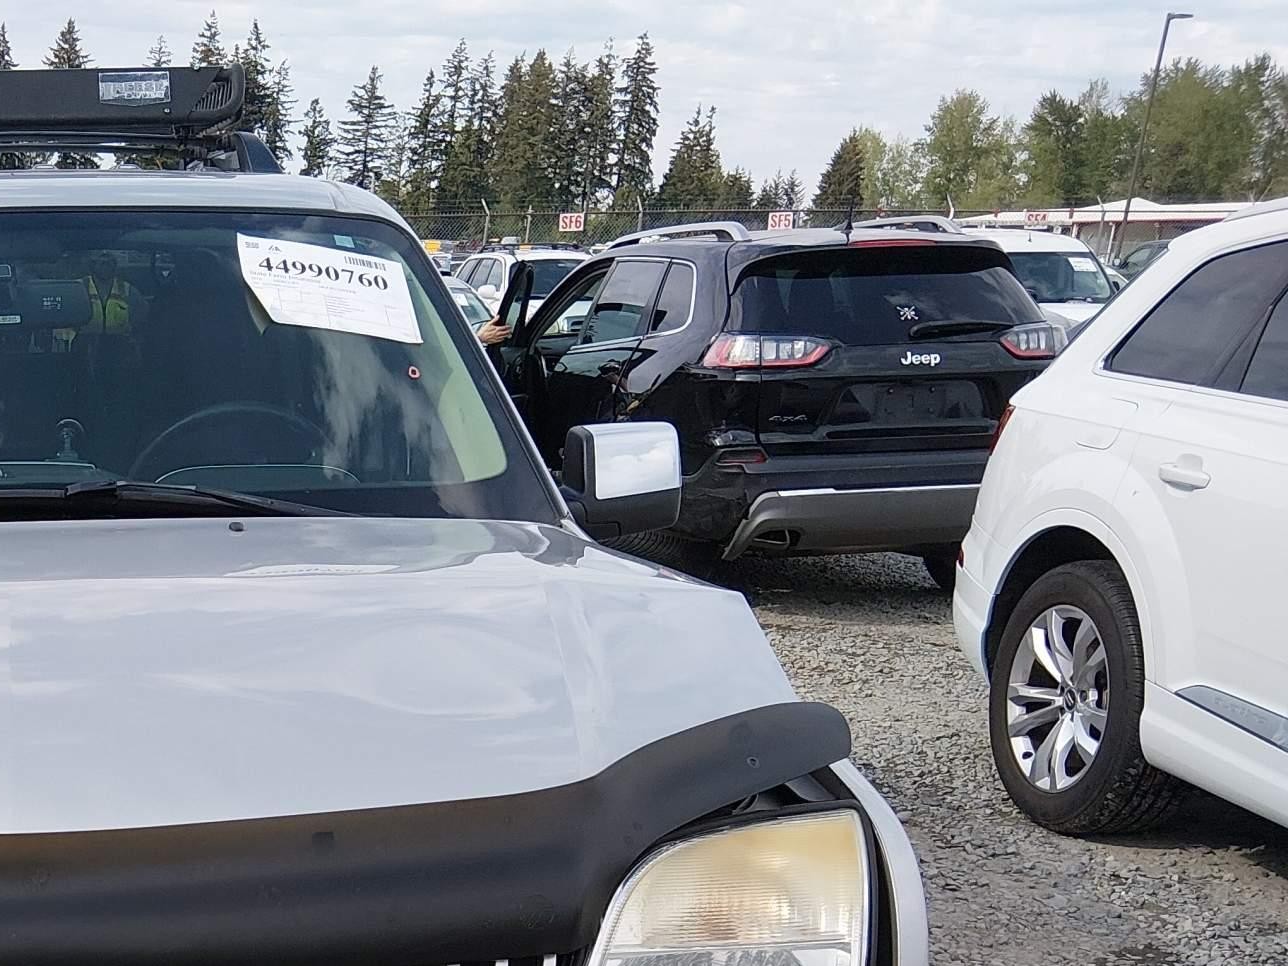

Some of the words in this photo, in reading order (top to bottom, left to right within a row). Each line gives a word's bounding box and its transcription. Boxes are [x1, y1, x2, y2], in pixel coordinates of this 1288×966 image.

[561, 215, 582, 230] SF6
[770, 213, 791, 228] SF5
[258, 256, 389, 291] 44990760
[900, 351, 941, 367] Jeep
